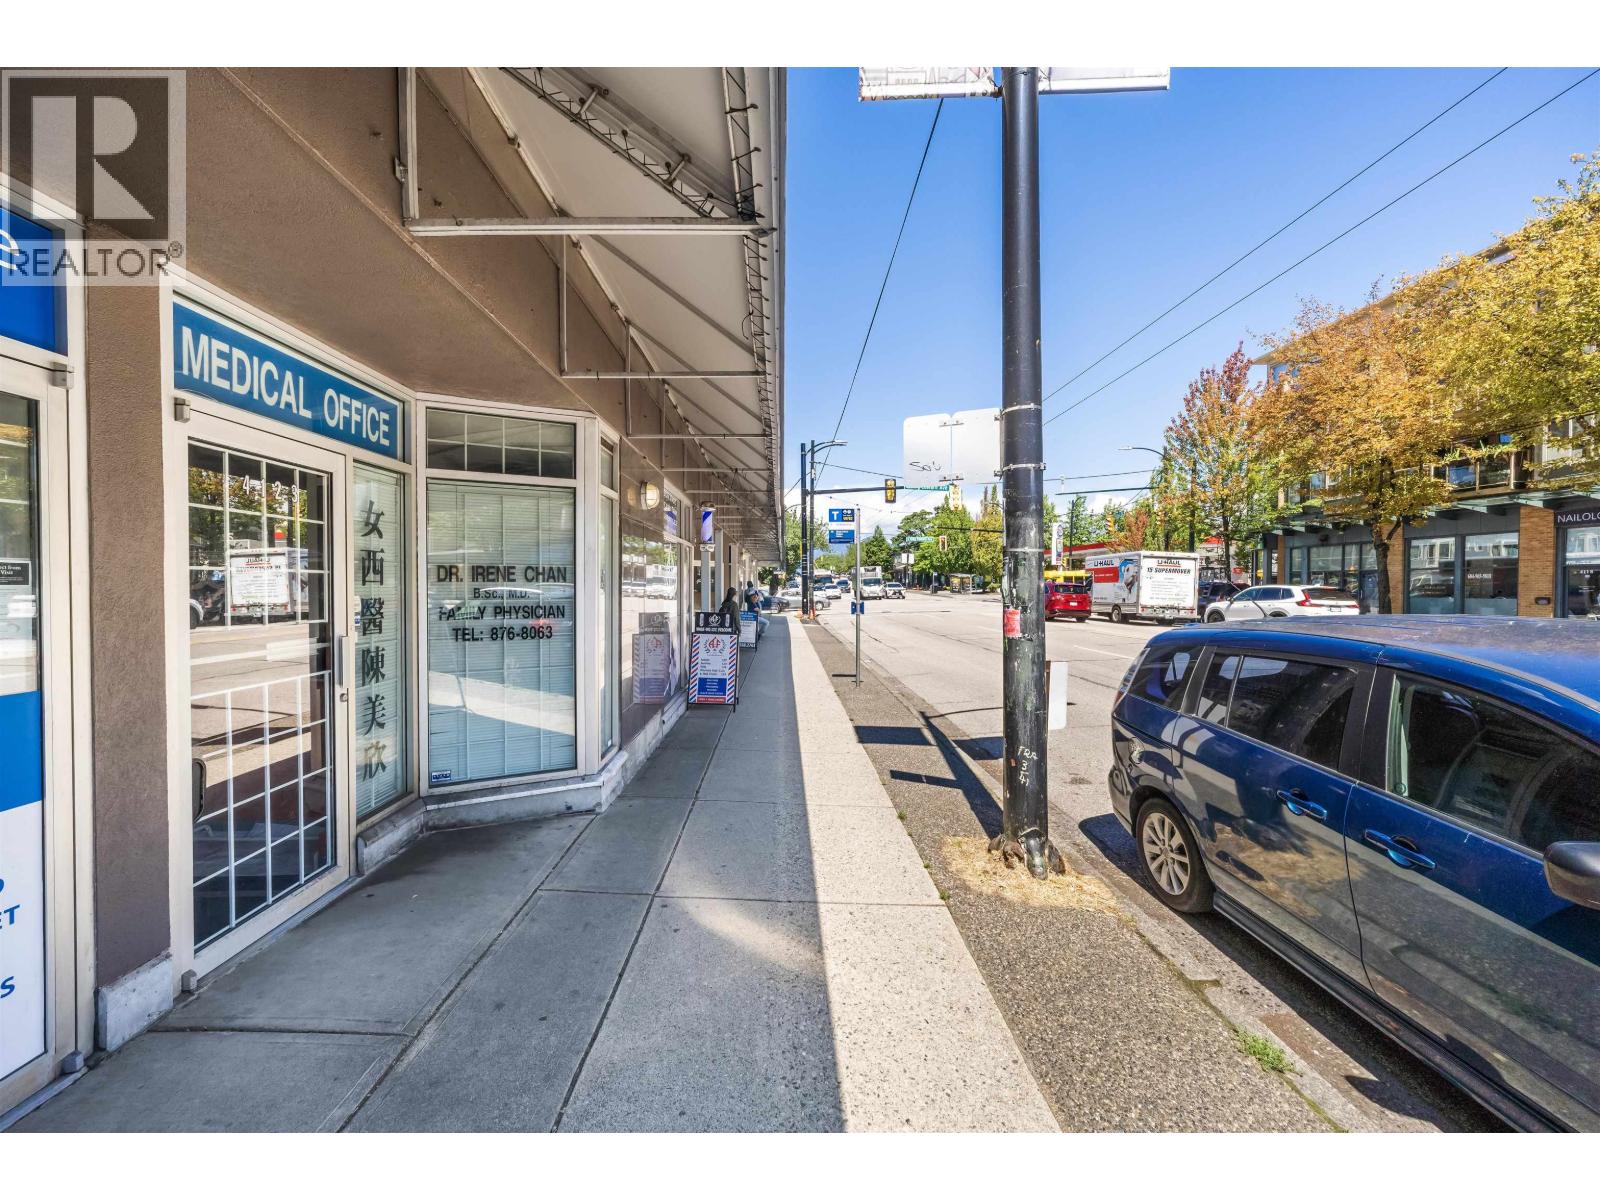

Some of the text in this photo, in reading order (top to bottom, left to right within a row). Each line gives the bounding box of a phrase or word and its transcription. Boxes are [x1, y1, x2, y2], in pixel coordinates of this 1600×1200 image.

[182, 326, 390, 447] MEDICAL OFFICE
[1093, 559, 1114, 567] U-HAUL
[437, 565, 567, 582] DR. IRENE CHAN
[494, 605, 565, 619] PHYSICIAN
[452, 625, 553, 641] TEL: 876-8063
